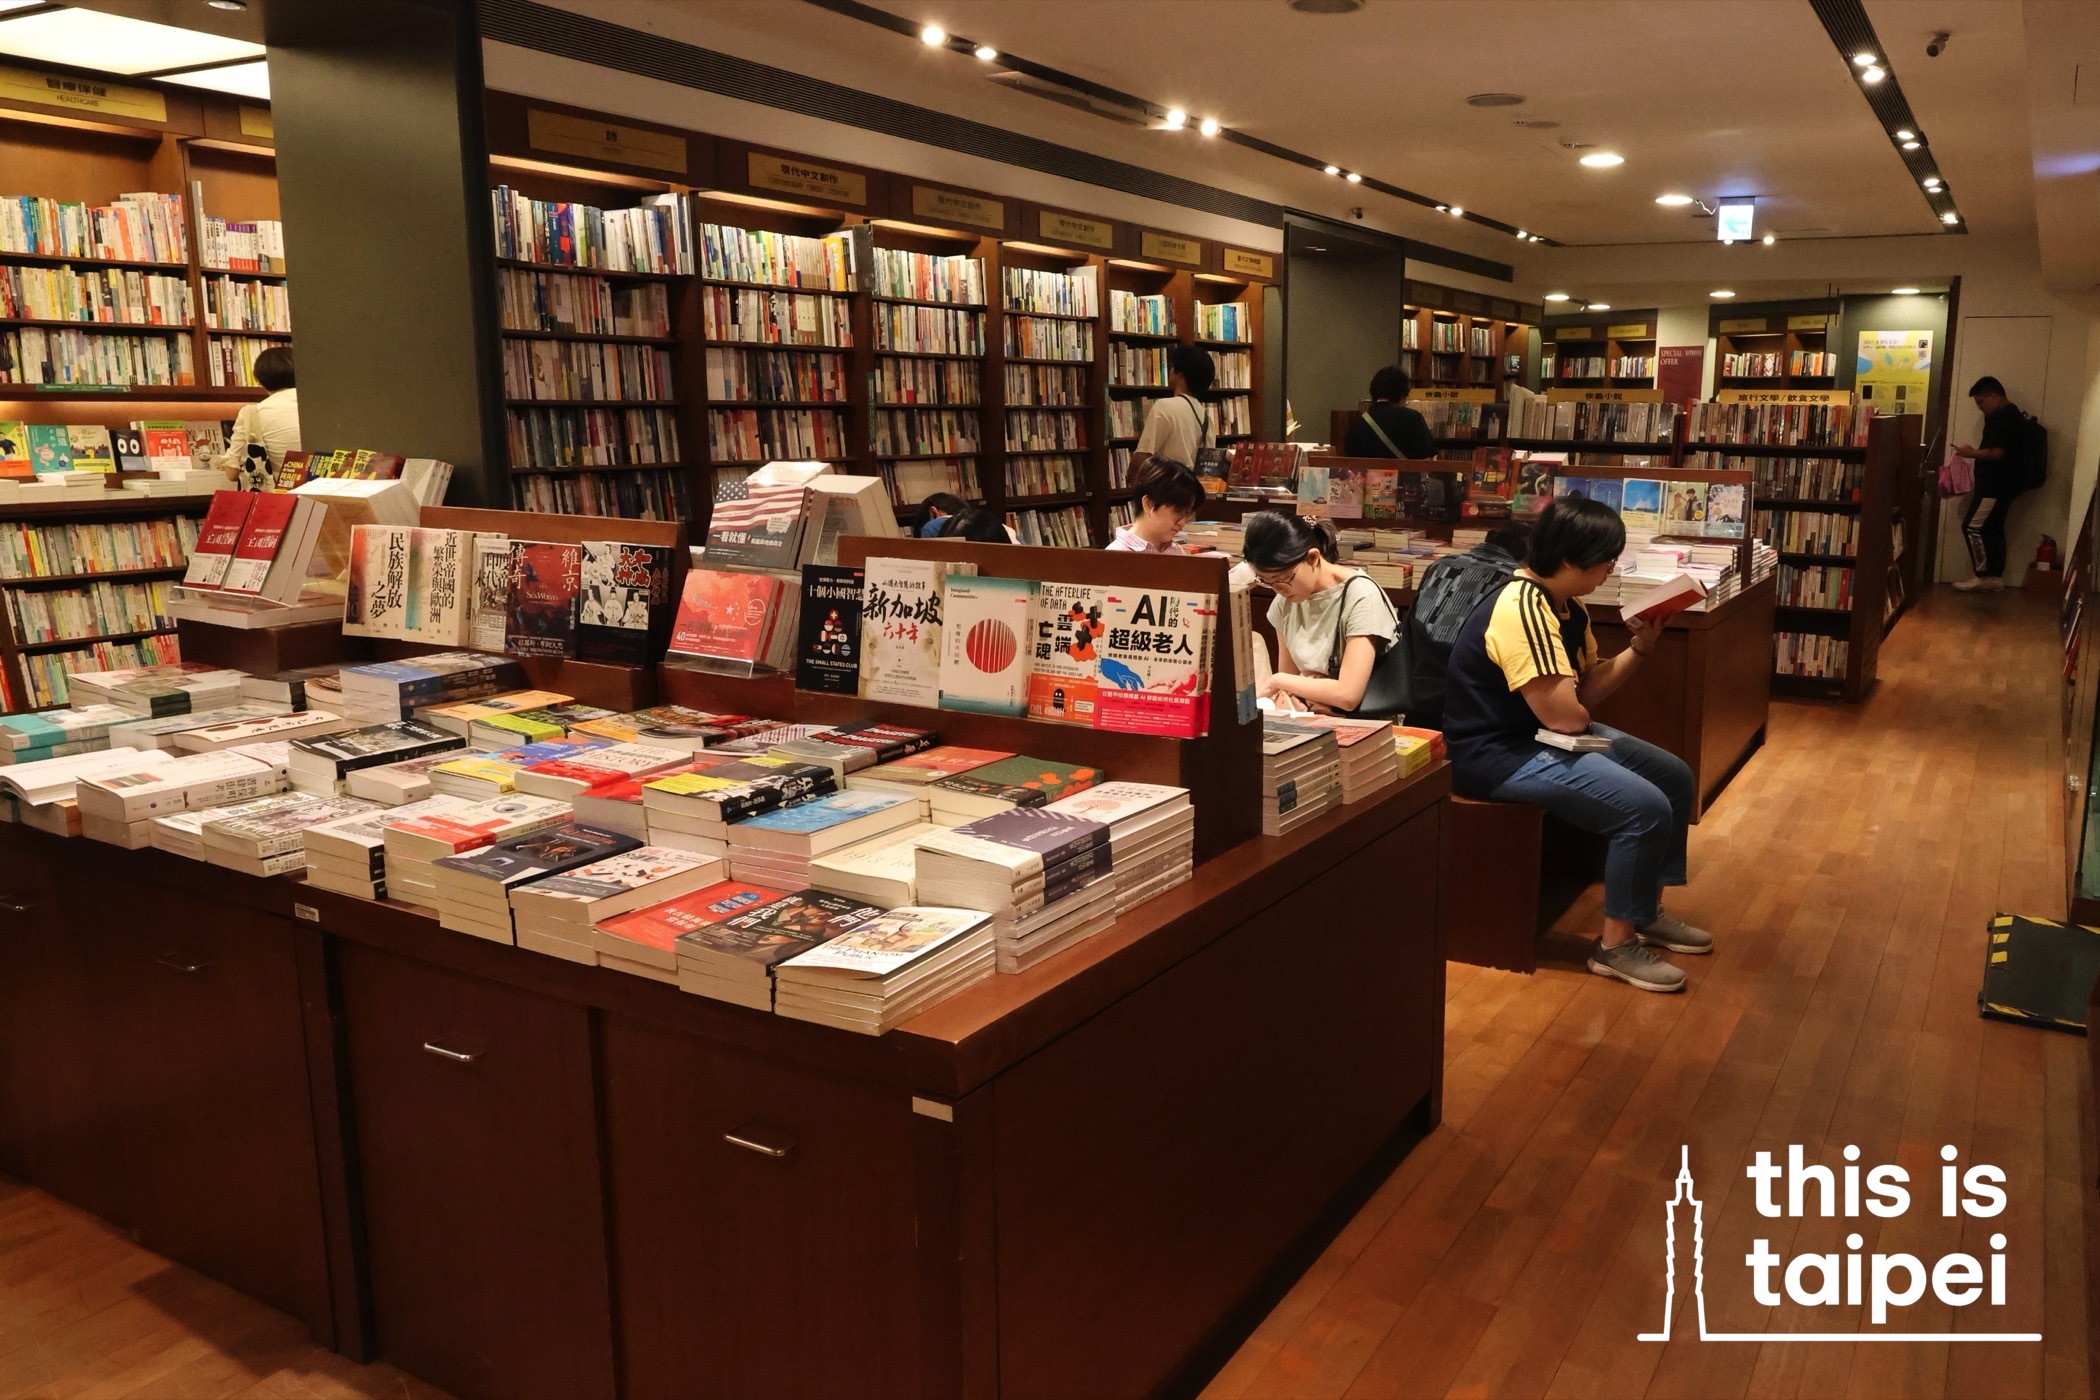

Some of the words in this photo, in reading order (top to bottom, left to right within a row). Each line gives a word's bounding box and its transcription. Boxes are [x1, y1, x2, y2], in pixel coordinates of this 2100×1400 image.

[47, 78, 107, 98] 醫療保健
[56, 94, 99, 107] HEALTHCARE
[1660, 349, 1683, 358] SPECIAL
[1660, 358, 1679, 366] OFFER
[387, 532, 404, 609] 民族解放
[440, 531, 457, 610] 近世帝國的
[508, 543, 529, 590] 傳奇
[560, 547, 581, 592] 維京
[369, 580, 387, 619] 之夢
[429, 545, 444, 624] 繁榮與歐洲
[1041, 585, 1054, 597] THE
[1055, 586, 1092, 600] AFTERLIFE
[862, 582, 943, 627] 新加坡
[1040, 599, 1048, 609] OF
[1050, 600, 1067, 611] DATA
[1130, 594, 1168, 627] AI
[1168, 596, 1181, 628] 時代的
[883, 622, 919, 644] 六十年
[1035, 620, 1054, 661] 亡魂
[1054, 613, 1073, 654] 雲端
[1108, 628, 1194, 656] 超級老人
[815, 659, 830, 667] SMALL
[830, 660, 846, 668] STATES
[846, 661, 858, 669] CLUB
